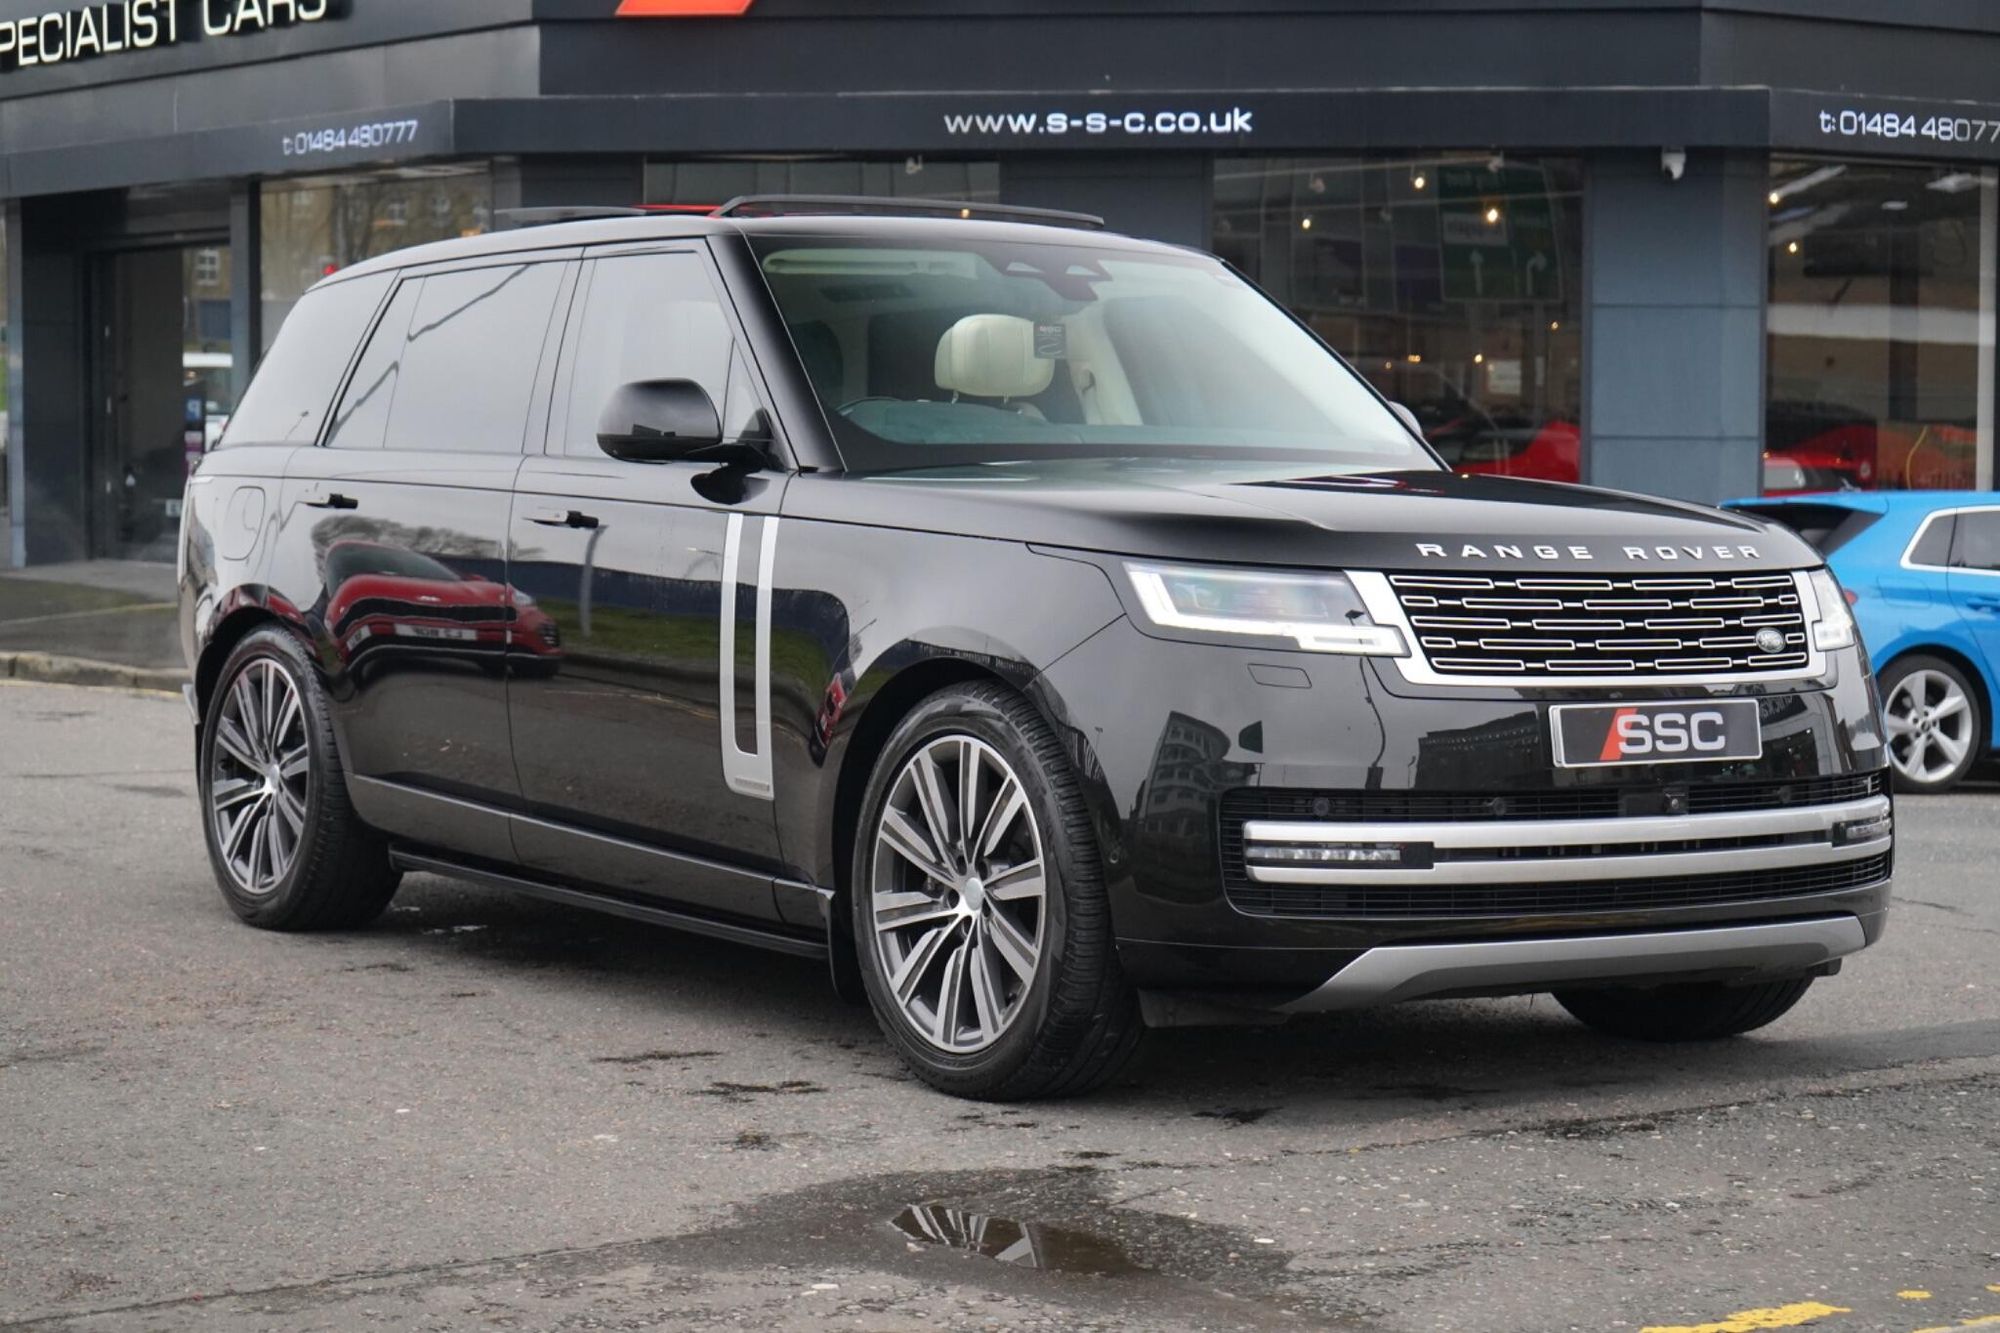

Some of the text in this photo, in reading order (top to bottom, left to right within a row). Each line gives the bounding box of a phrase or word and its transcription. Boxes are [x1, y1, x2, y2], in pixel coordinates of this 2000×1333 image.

[0, 0, 176, 66] PECIALIST
[943, 106, 1253, 134] www.s-s-c.co.uk
[1415, 542, 1761, 561] RANGE ROVER
[1616, 711, 1726, 754] SSC
